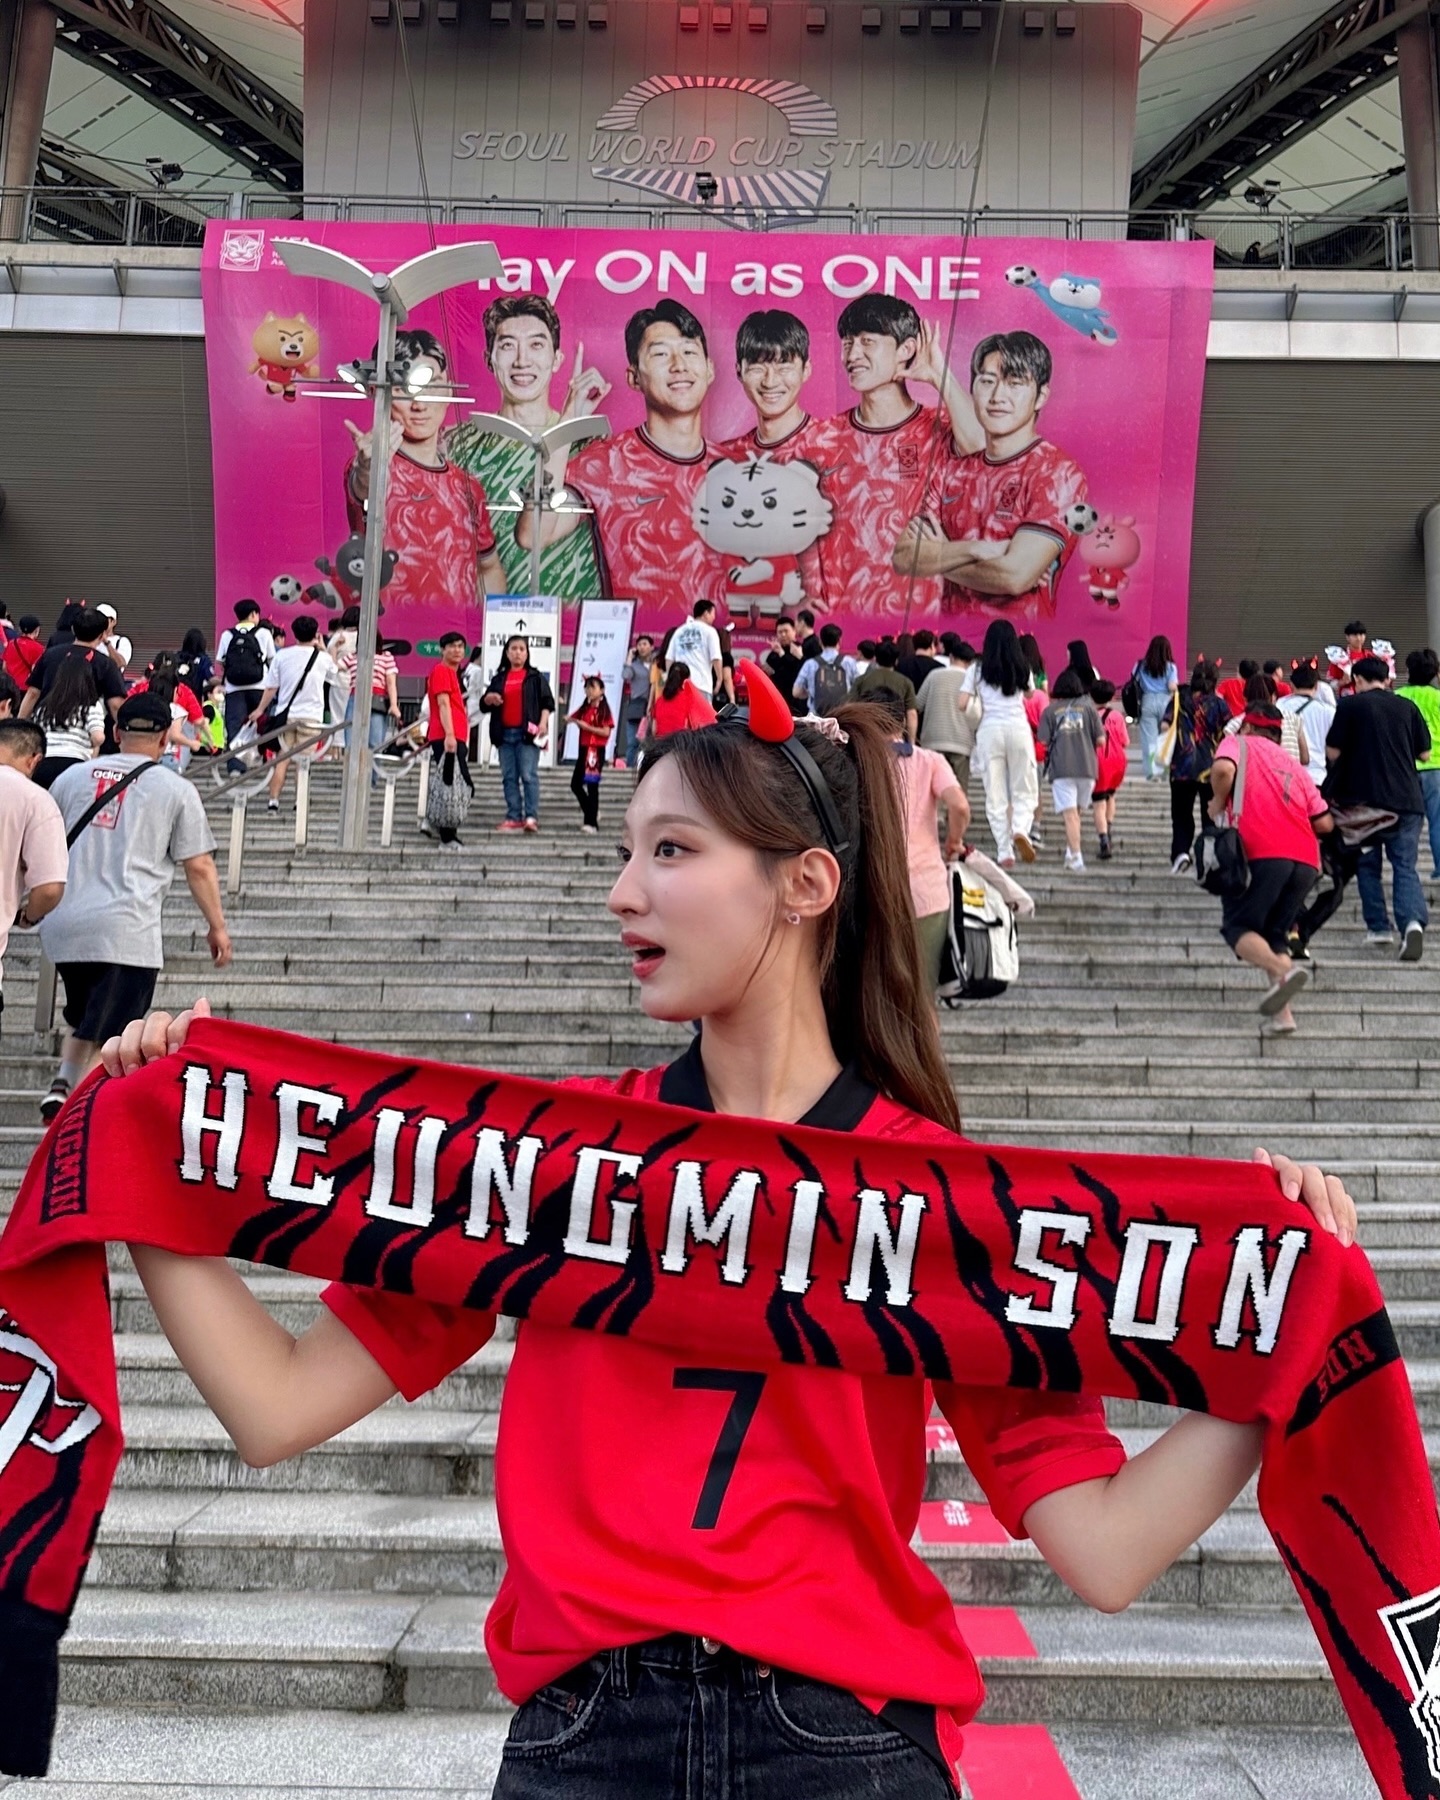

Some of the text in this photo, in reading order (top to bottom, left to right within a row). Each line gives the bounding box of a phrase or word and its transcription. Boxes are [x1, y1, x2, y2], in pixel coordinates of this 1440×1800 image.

[452, 131, 983, 170] SEOUL WORLD CUP STADIUM
[478, 249, 982, 307] ay ON as ONE
[48, 1080, 101, 1218] UNGMIN
[179, 1065, 1308, 1354] HEUNGMIN SON
[1316, 1329, 1376, 1404] SON
[672, 1366, 768, 1531] 7
